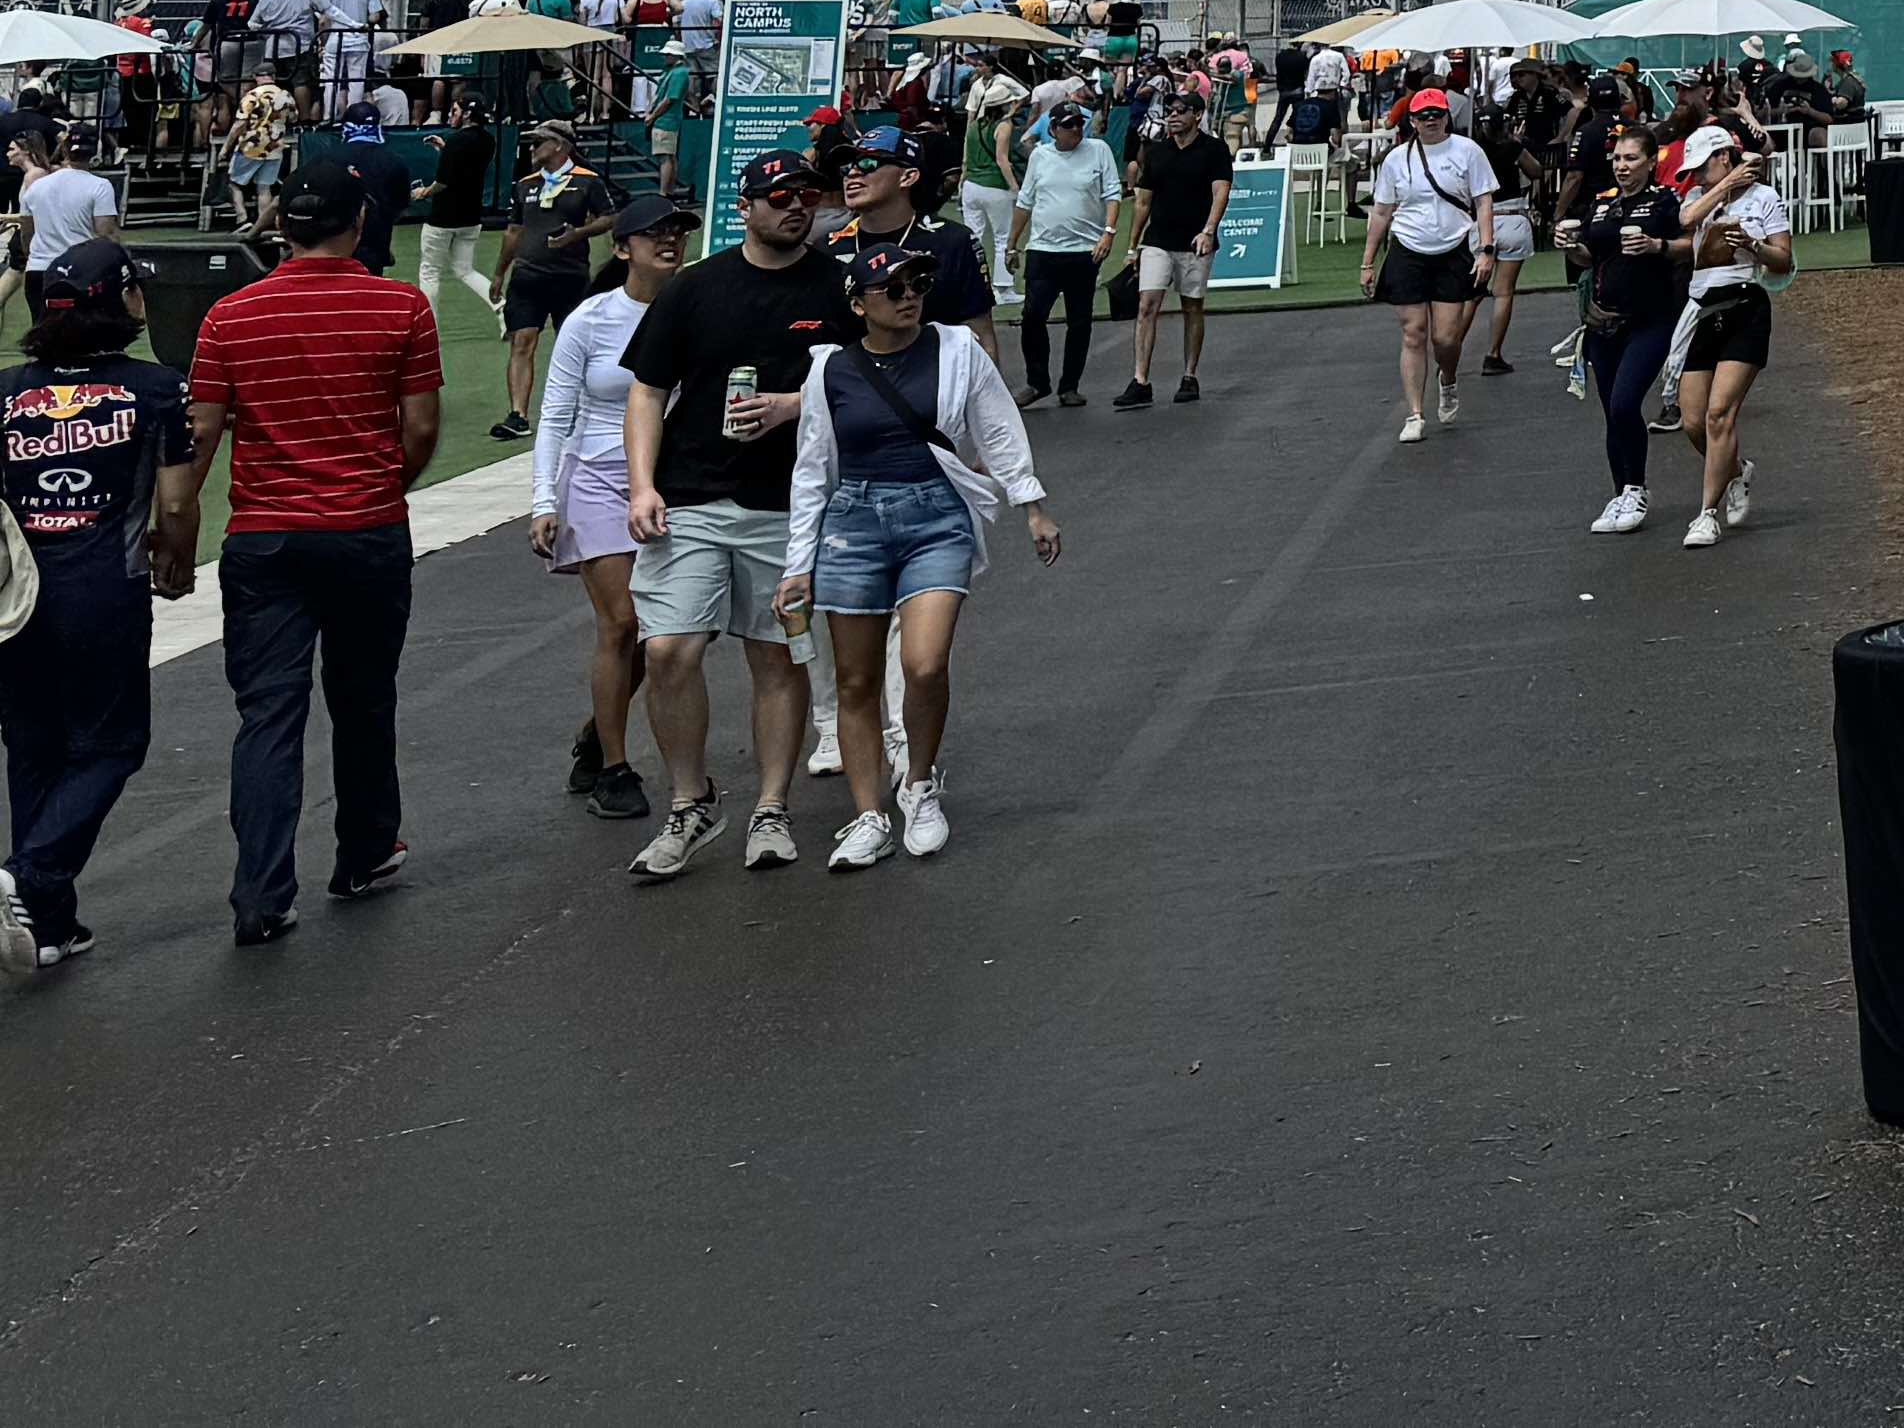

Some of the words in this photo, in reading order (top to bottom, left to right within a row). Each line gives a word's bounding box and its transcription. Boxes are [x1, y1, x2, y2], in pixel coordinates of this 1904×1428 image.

[735, 7, 782, 17] NORTH
[734, 18, 792, 28] CAMPUS
[4, 421, 67, 461] Red
[68, 408, 136, 453] Bull
[29, 513, 94, 528] TOTAL
